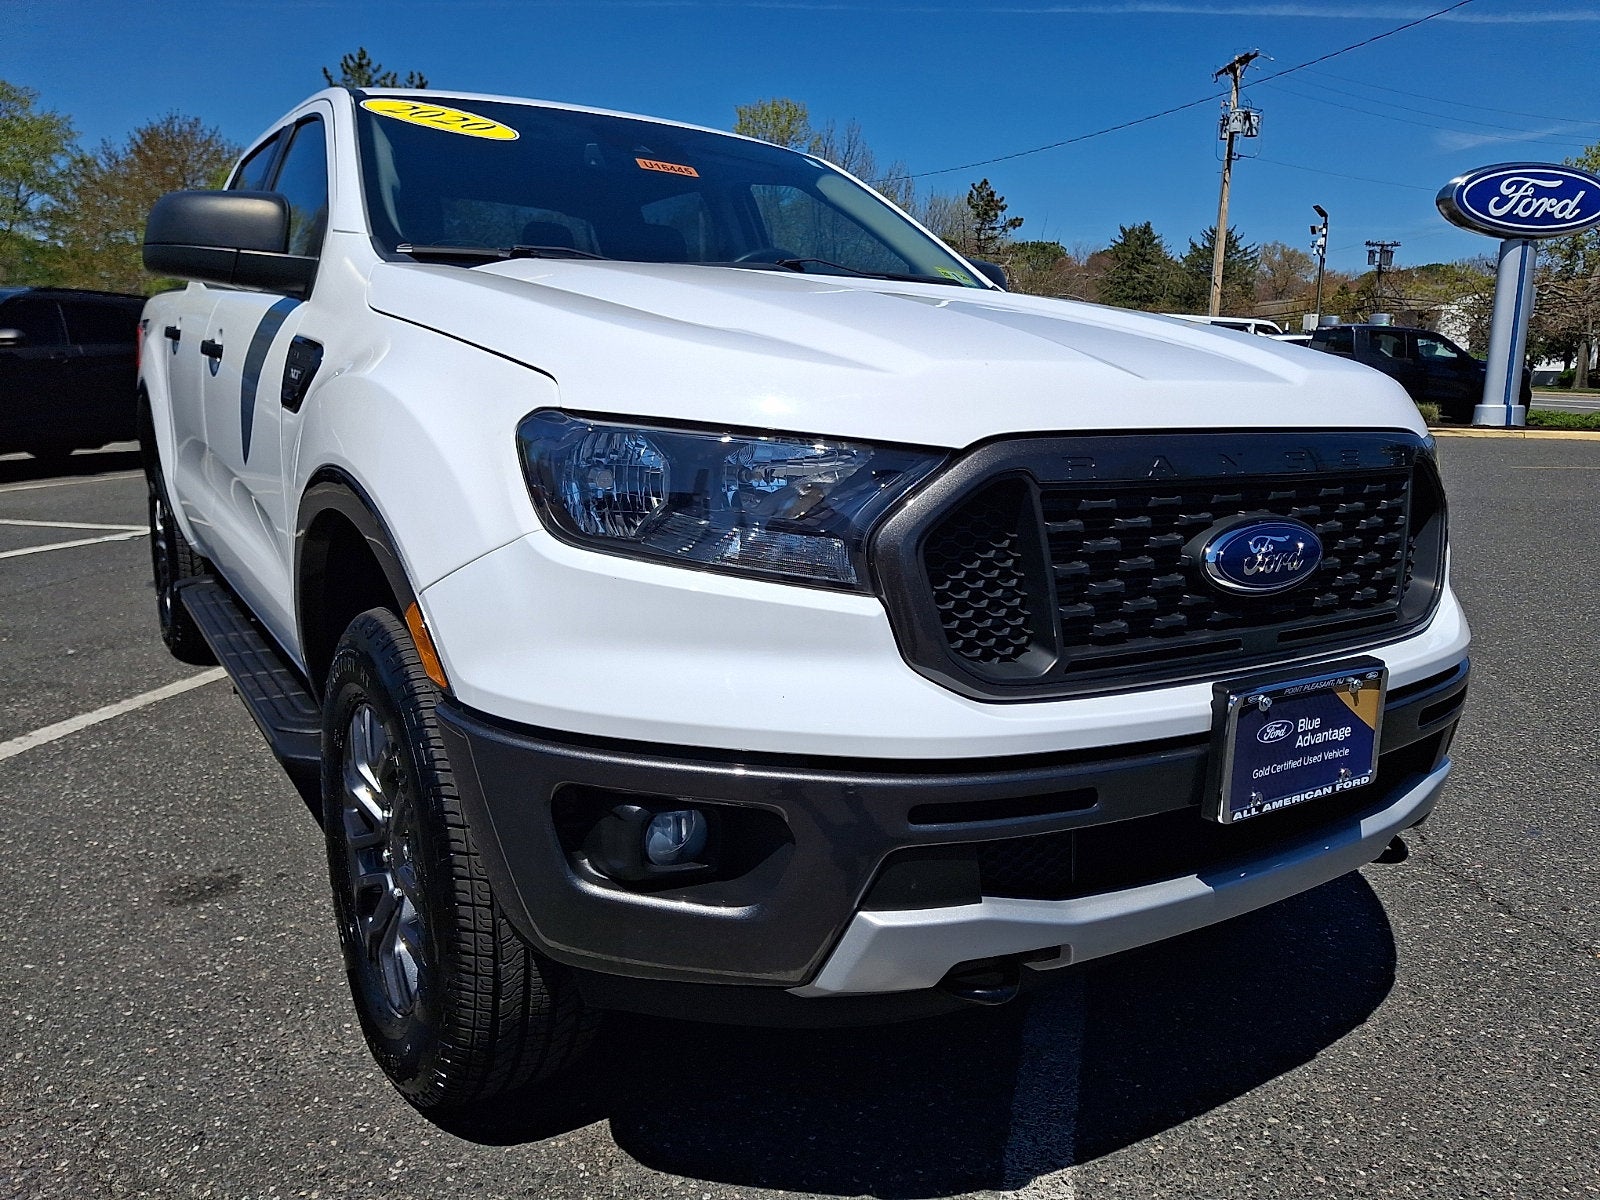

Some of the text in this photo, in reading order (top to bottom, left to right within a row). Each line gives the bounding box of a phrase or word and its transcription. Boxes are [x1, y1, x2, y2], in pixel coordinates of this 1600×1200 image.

[381, 104, 497, 131] 2020
[1488, 176, 1586, 220] Ford
[1243, 534, 1304, 576] Ford
[1283, 686, 1303, 695] POINT
[1335, 678, 1345, 686] NJ
[1295, 726, 1352, 749] Advantage
[1297, 716, 1321, 733] Blue
[1252, 747, 1350, 780] Gold Certified Used Vehicle
[1232, 776, 1370, 821] ALL AMERICAN FORD
